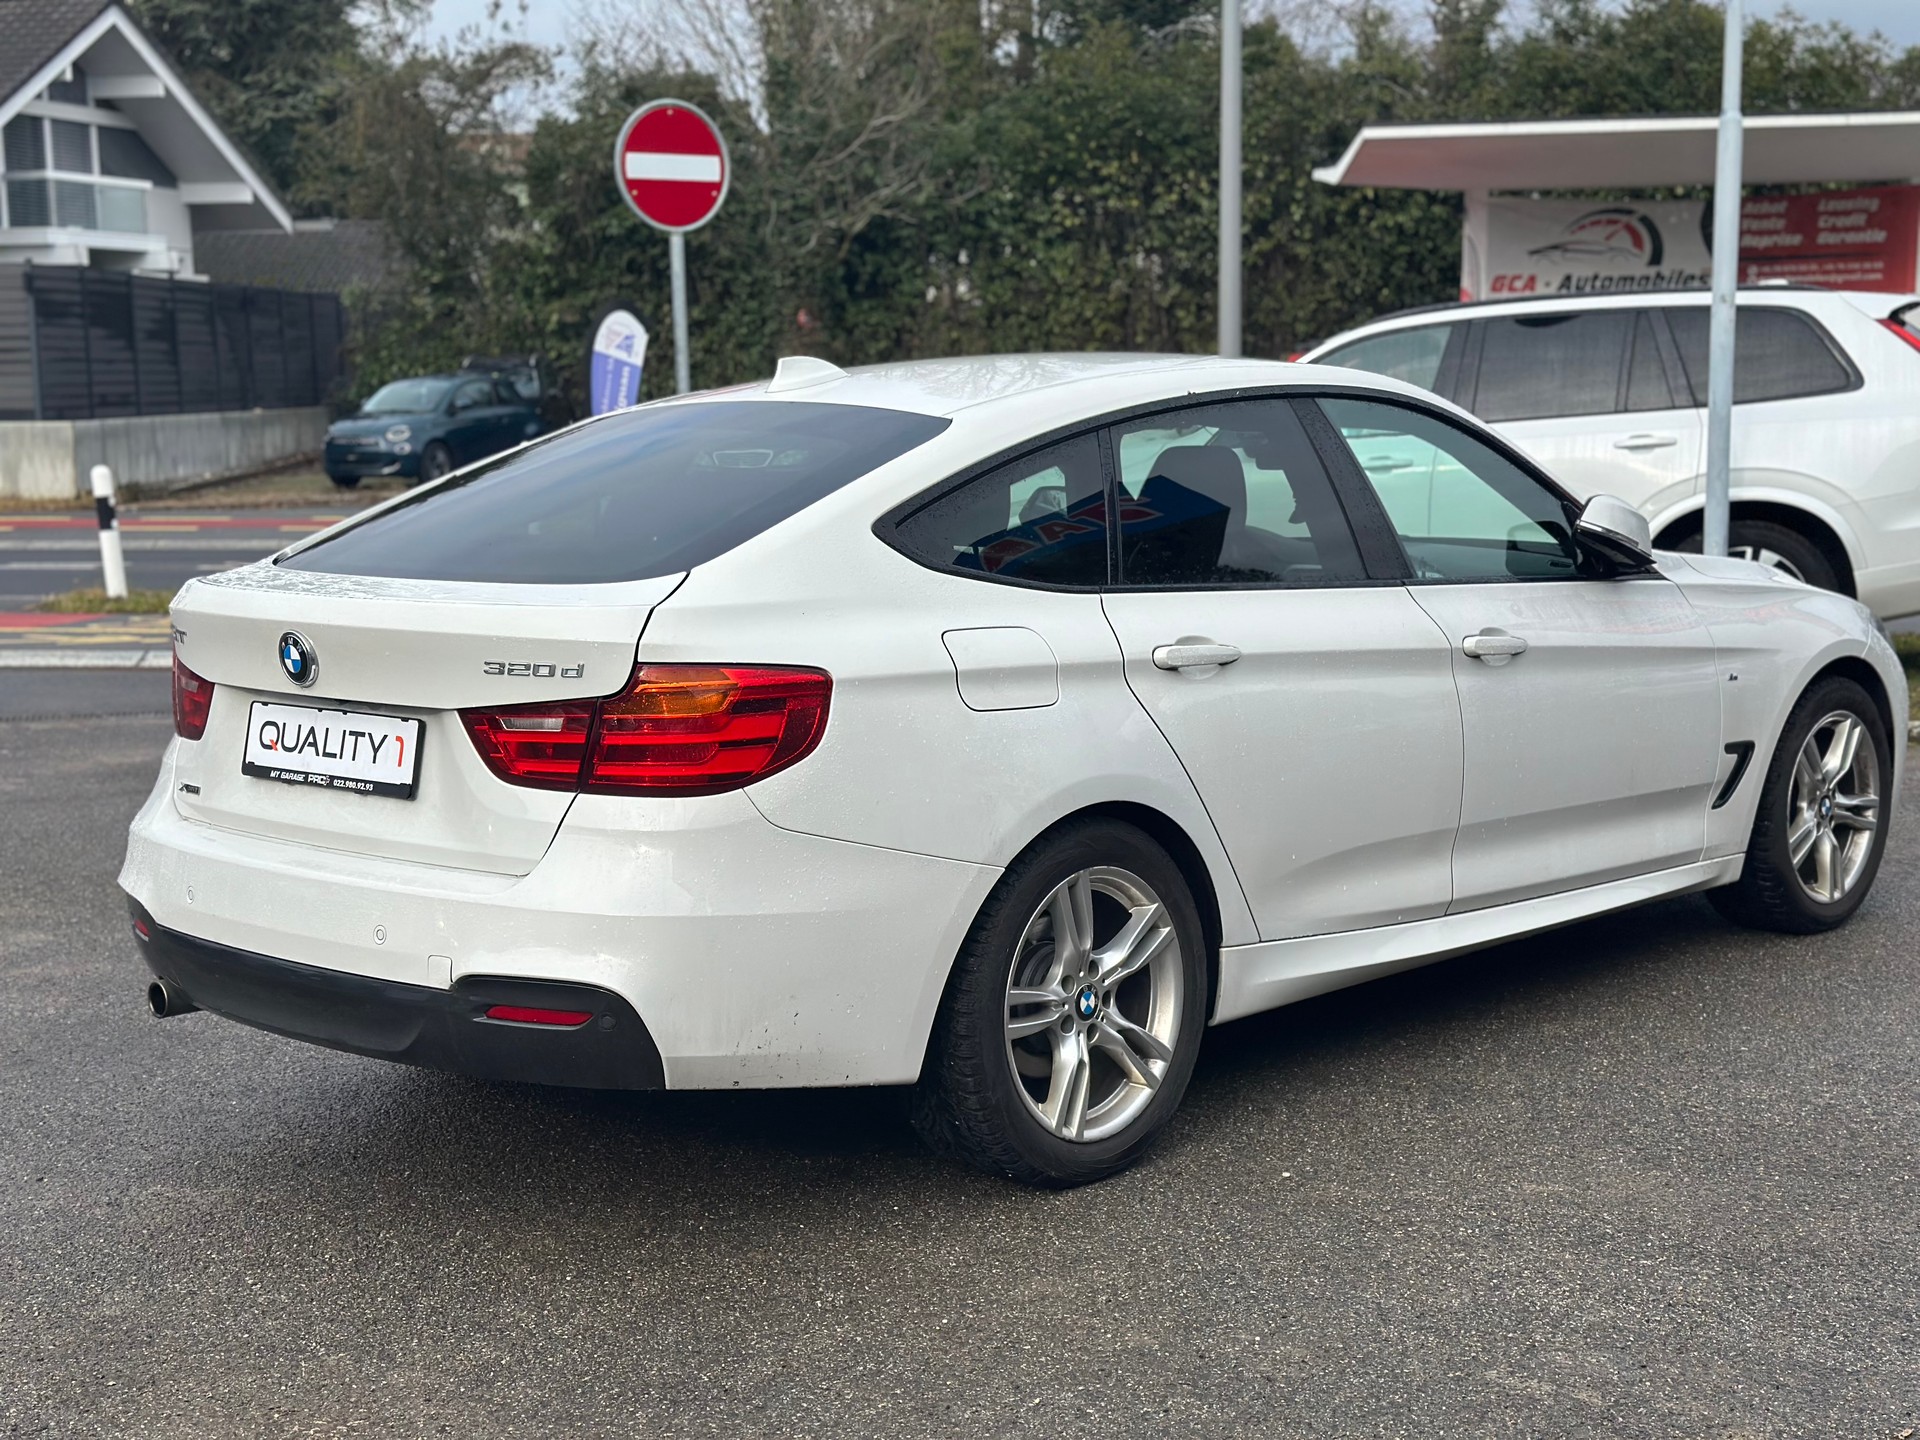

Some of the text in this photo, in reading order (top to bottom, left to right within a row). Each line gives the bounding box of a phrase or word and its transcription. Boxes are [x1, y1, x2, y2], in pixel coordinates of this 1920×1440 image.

[1817, 196, 1880, 213] Leasing
[1815, 227, 1888, 246] Garantie
[1490, 269, 1712, 293] GCA Automobiles
[259, 720, 405, 768] QUALITY 1
[269, 769, 281, 778] MY
[281, 771, 306, 782] GARAGE
[333, 778, 374, 792] 022.980.92.93
